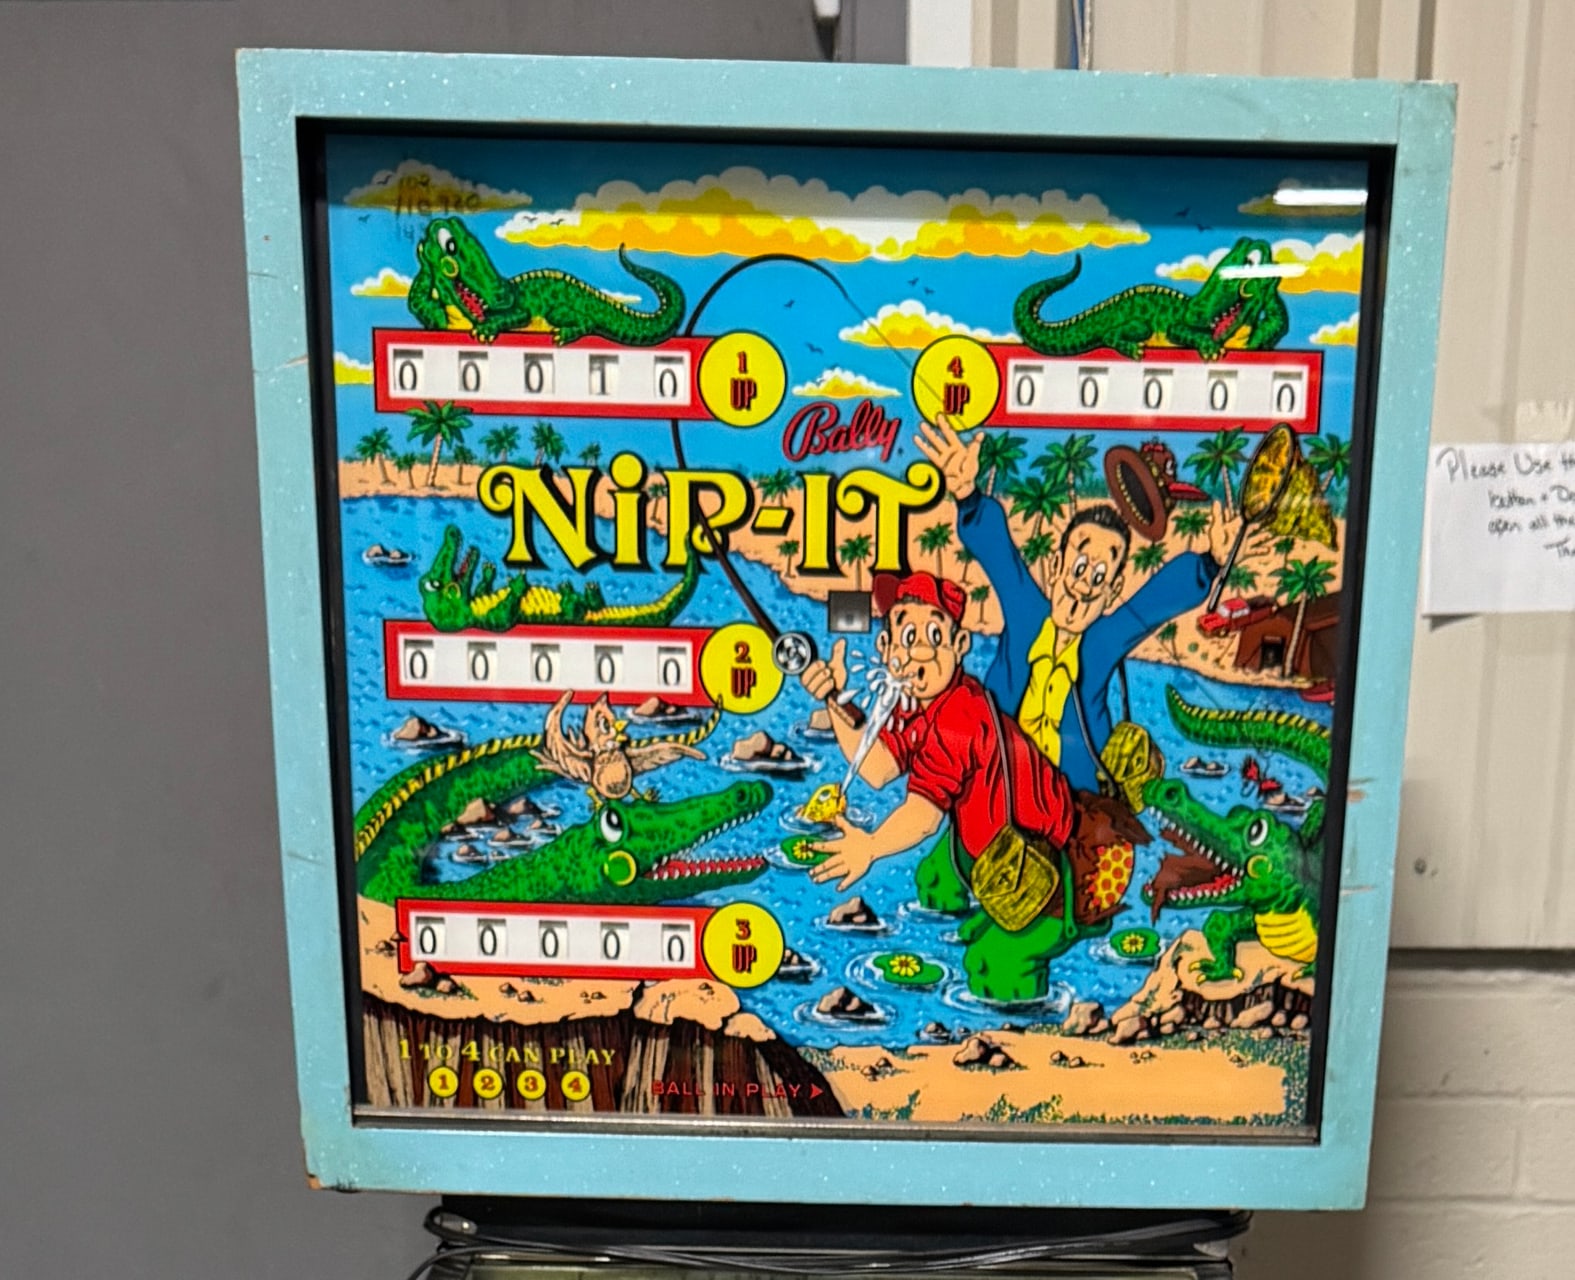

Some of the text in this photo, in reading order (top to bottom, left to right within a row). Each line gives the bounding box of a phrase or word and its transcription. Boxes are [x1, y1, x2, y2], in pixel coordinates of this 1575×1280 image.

[736, 352, 748, 374] 1
[947, 357, 963, 380] 4
[730, 378, 757, 411] UP
[944, 384, 970, 417] UP
[783, 400, 901, 461] Bally
[1436, 447, 1506, 483] Please
[1513, 453, 1551, 476] Use
[733, 643, 752, 665] 2
[730, 668, 757, 699] UP
[735, 919, 752, 940] 3
[732, 945, 757, 973] UP
[400, 1039, 615, 1066] 1 TO 4 CAN PLAY
[438, 1074, 583, 1093] 1 2 3 4
[652, 1081, 801, 1099] BALL IN PLAY
